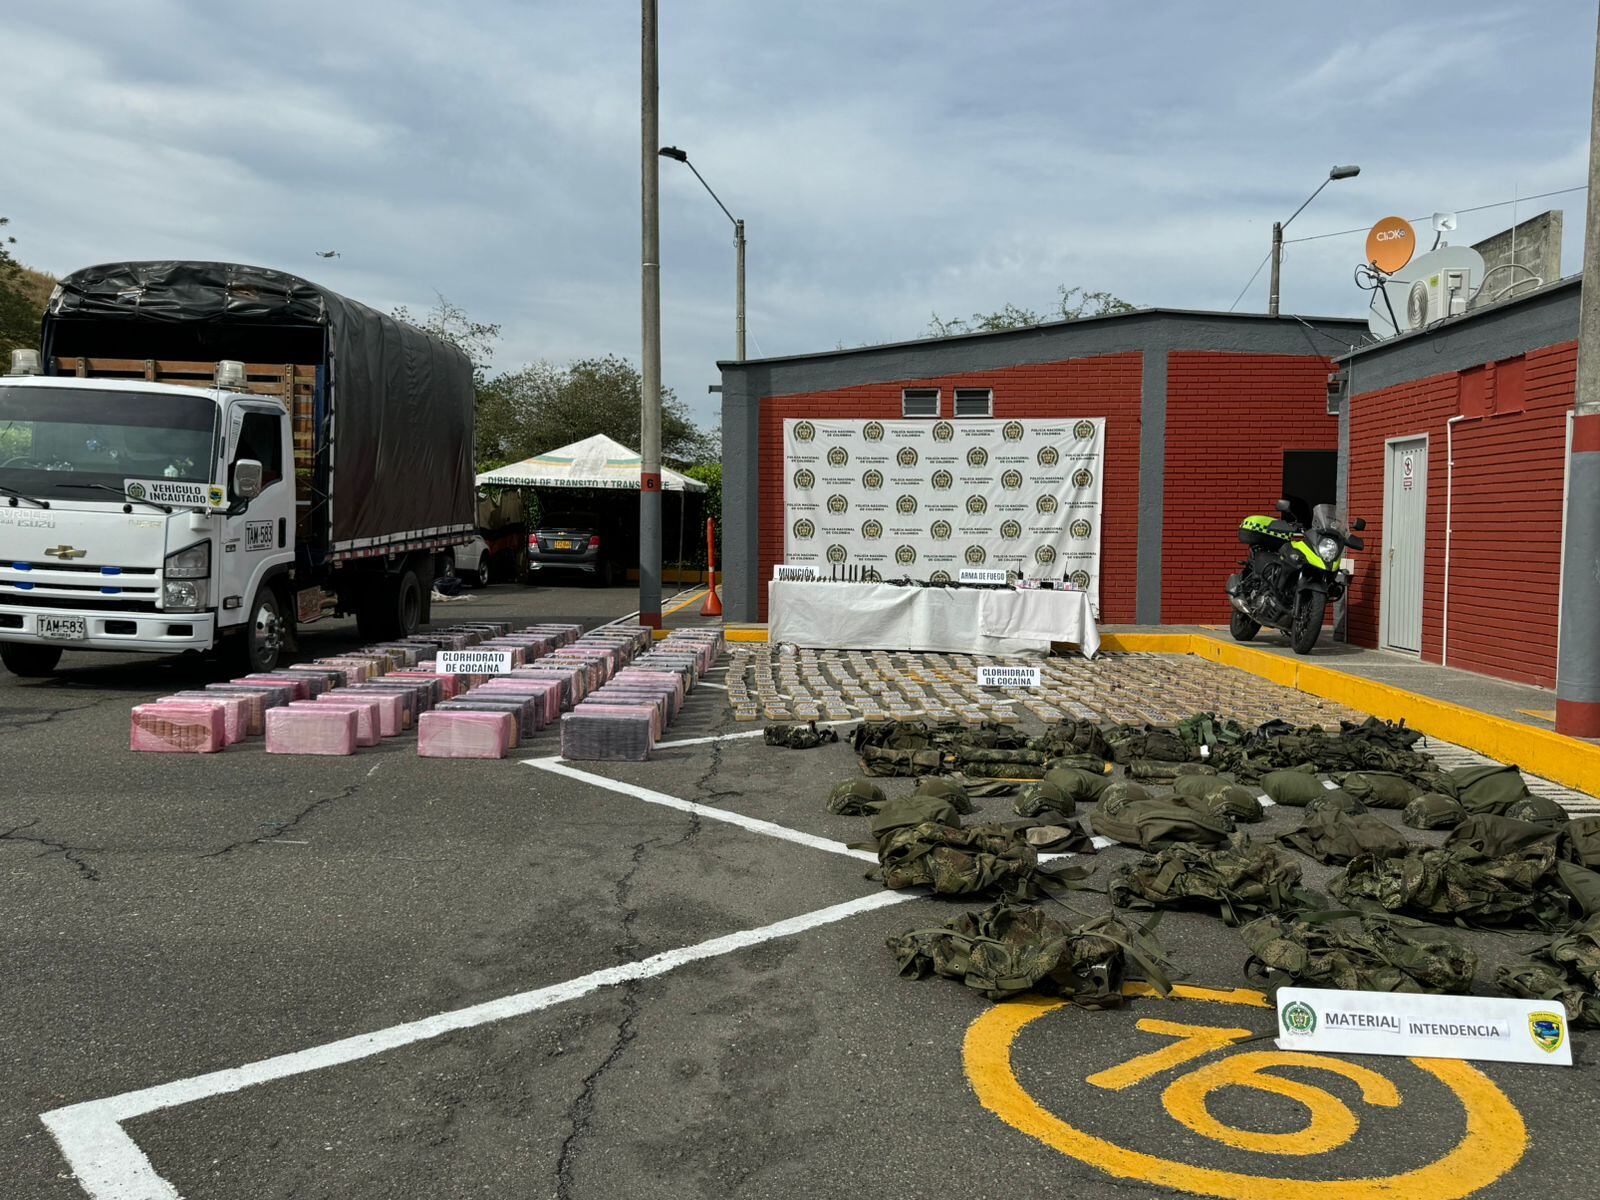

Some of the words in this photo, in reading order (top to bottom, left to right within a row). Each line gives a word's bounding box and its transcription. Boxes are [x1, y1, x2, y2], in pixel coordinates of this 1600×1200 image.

[602, 480, 608, 488] Y
[647, 479, 654, 488] 6
[150, 492, 206, 504] INCAUTADO
[961, 572, 978, 580] ARMA
[987, 572, 1004, 580] FUEGO
[39, 620, 83, 633] TAM-583
[442, 652, 504, 662] CLORHIDRATO
[446, 664, 457, 672] DE
[460, 662, 499, 672] COCAÍNA
[982, 668, 1034, 677] CLORHIDRATO
[1326, 1012, 1399, 1028] MATERIAL
[1409, 1022, 1500, 1037] INTENDENCIA
